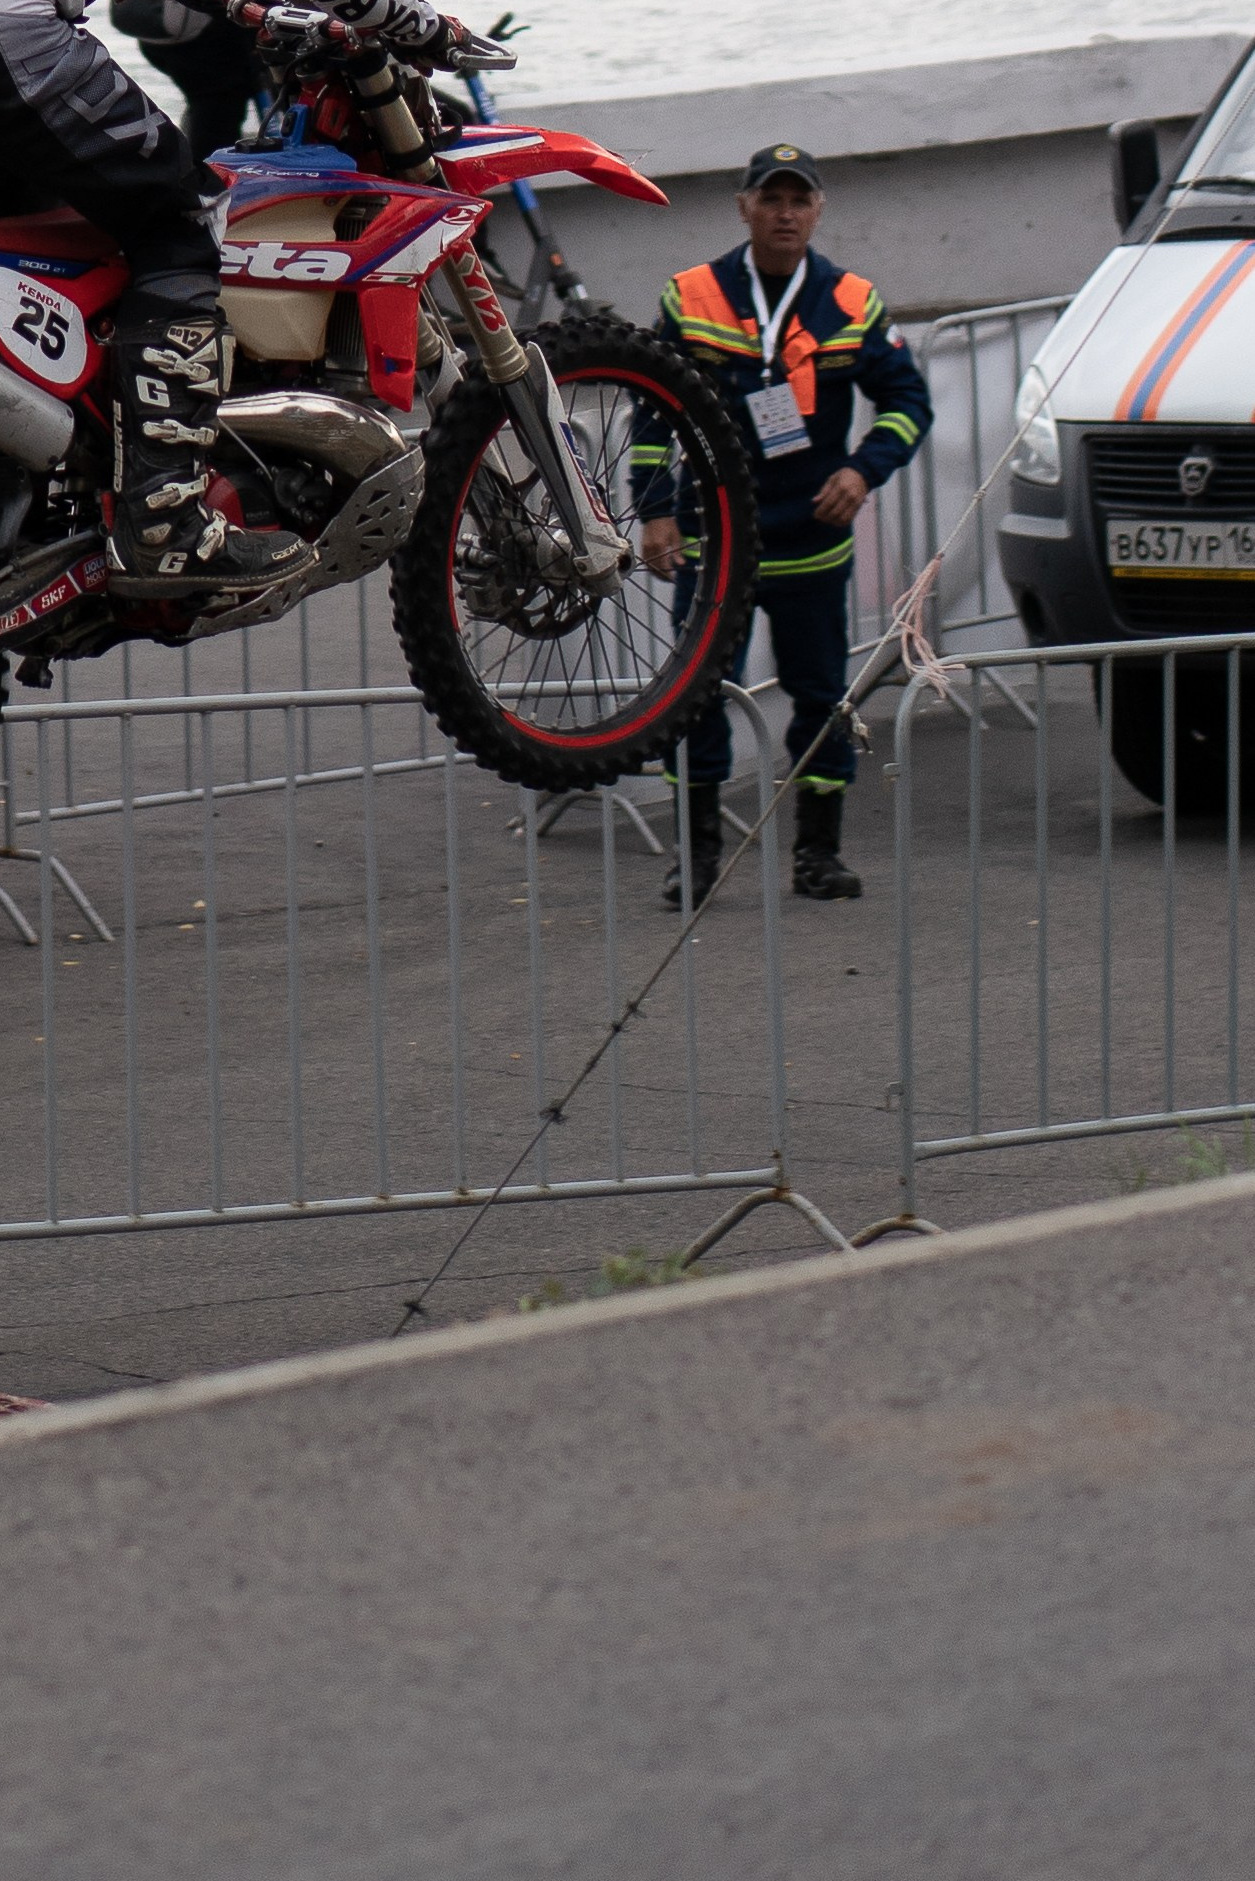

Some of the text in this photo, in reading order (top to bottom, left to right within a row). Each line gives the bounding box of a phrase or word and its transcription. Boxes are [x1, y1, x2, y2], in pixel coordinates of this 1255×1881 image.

[219, 242, 352, 282] eta
[17, 281, 61, 312] KENDA
[12, 295, 70, 361] 25
[41, 585, 66, 609] SKF
